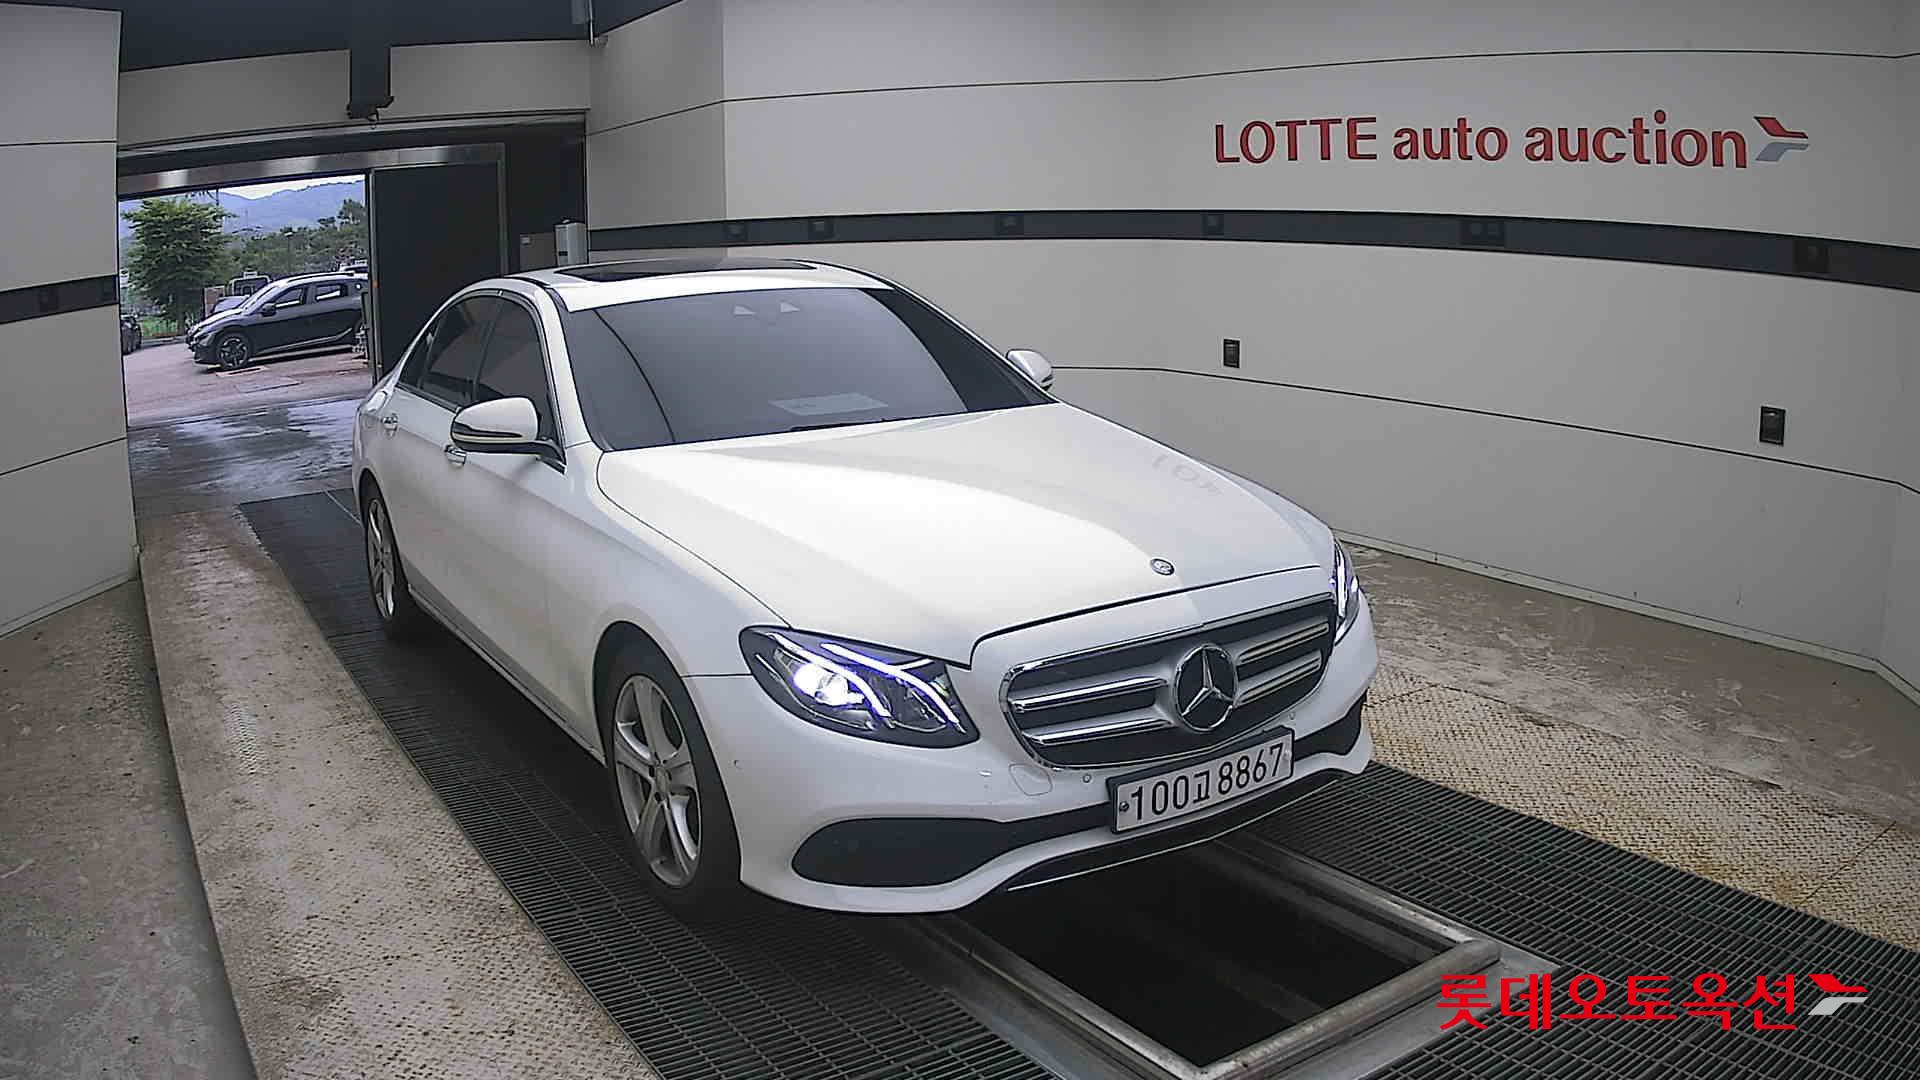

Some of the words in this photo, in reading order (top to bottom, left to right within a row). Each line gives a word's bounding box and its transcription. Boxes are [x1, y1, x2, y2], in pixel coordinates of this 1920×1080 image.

[1215, 117, 1377, 164] LOTTE
[1392, 118, 1508, 162] auto
[1524, 109, 1748, 169] auction
